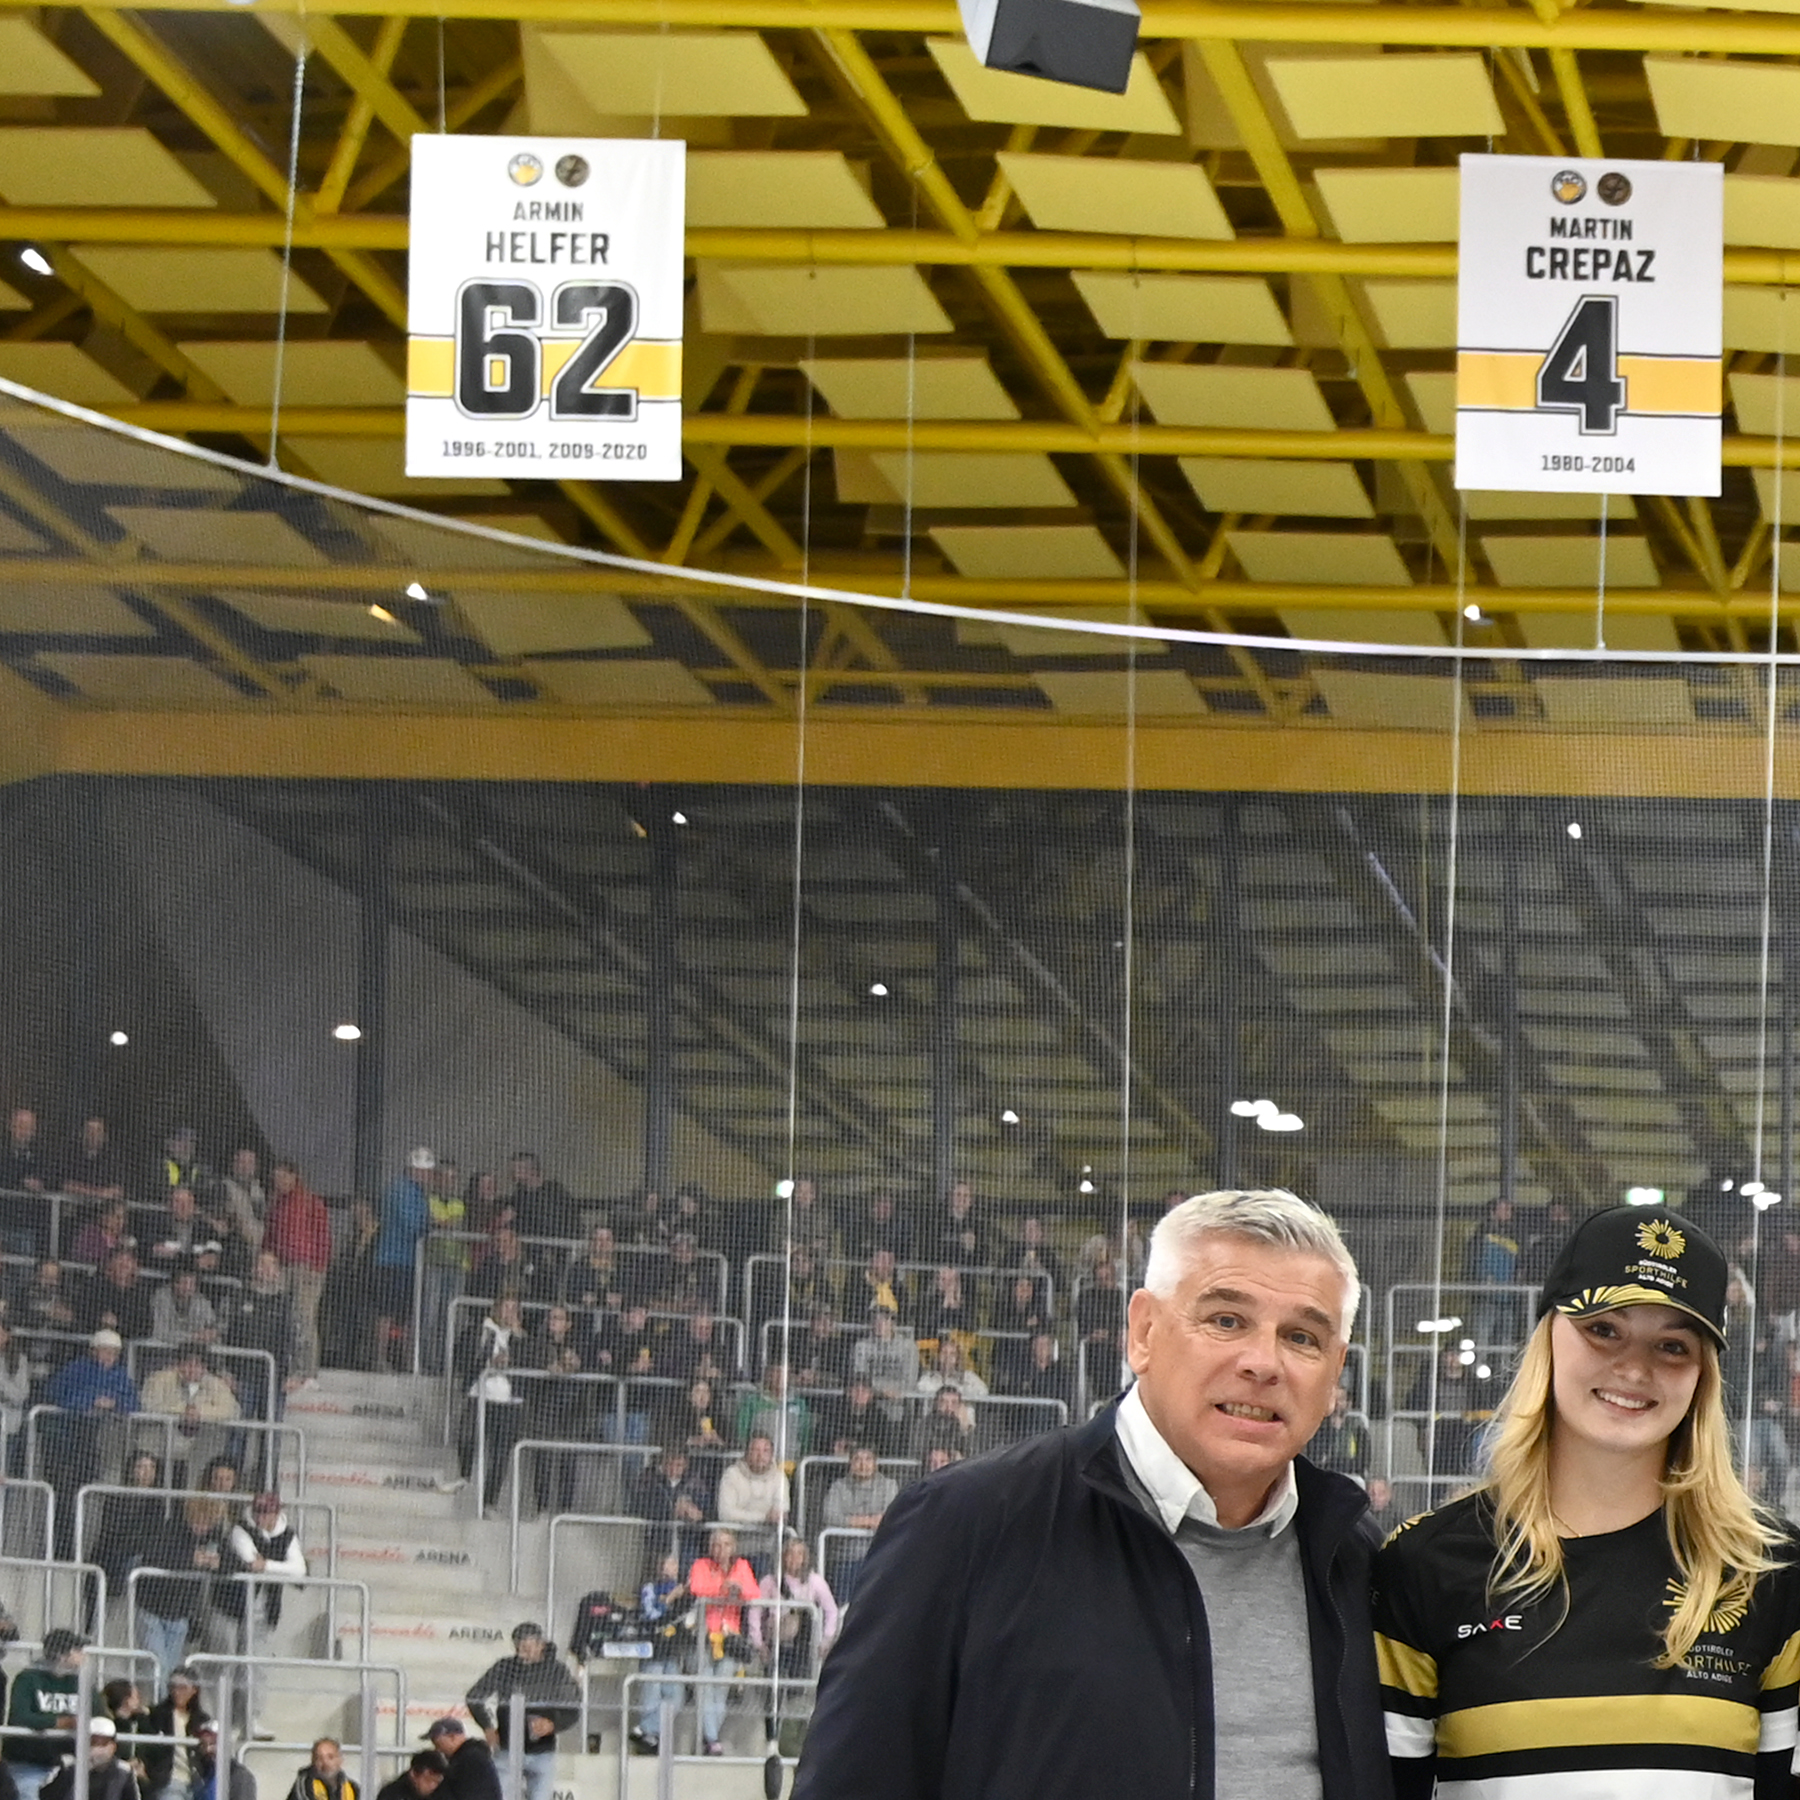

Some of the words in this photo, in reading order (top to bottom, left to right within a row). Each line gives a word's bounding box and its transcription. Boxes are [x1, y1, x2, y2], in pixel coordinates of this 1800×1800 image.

[513, 201, 583, 222] ARMIN
[1550, 217, 1633, 241] MARTIN
[485, 231, 610, 264] HELFER
[1526, 246, 1656, 282] CREPAZ
[454, 277, 639, 422] 62
[1535, 294, 1628, 436] 4
[1541, 455, 1636, 473] 1980-2004
[1624, 1264, 1689, 1289] SPORTHILFE
[448, 1627, 505, 1642] ARENA
